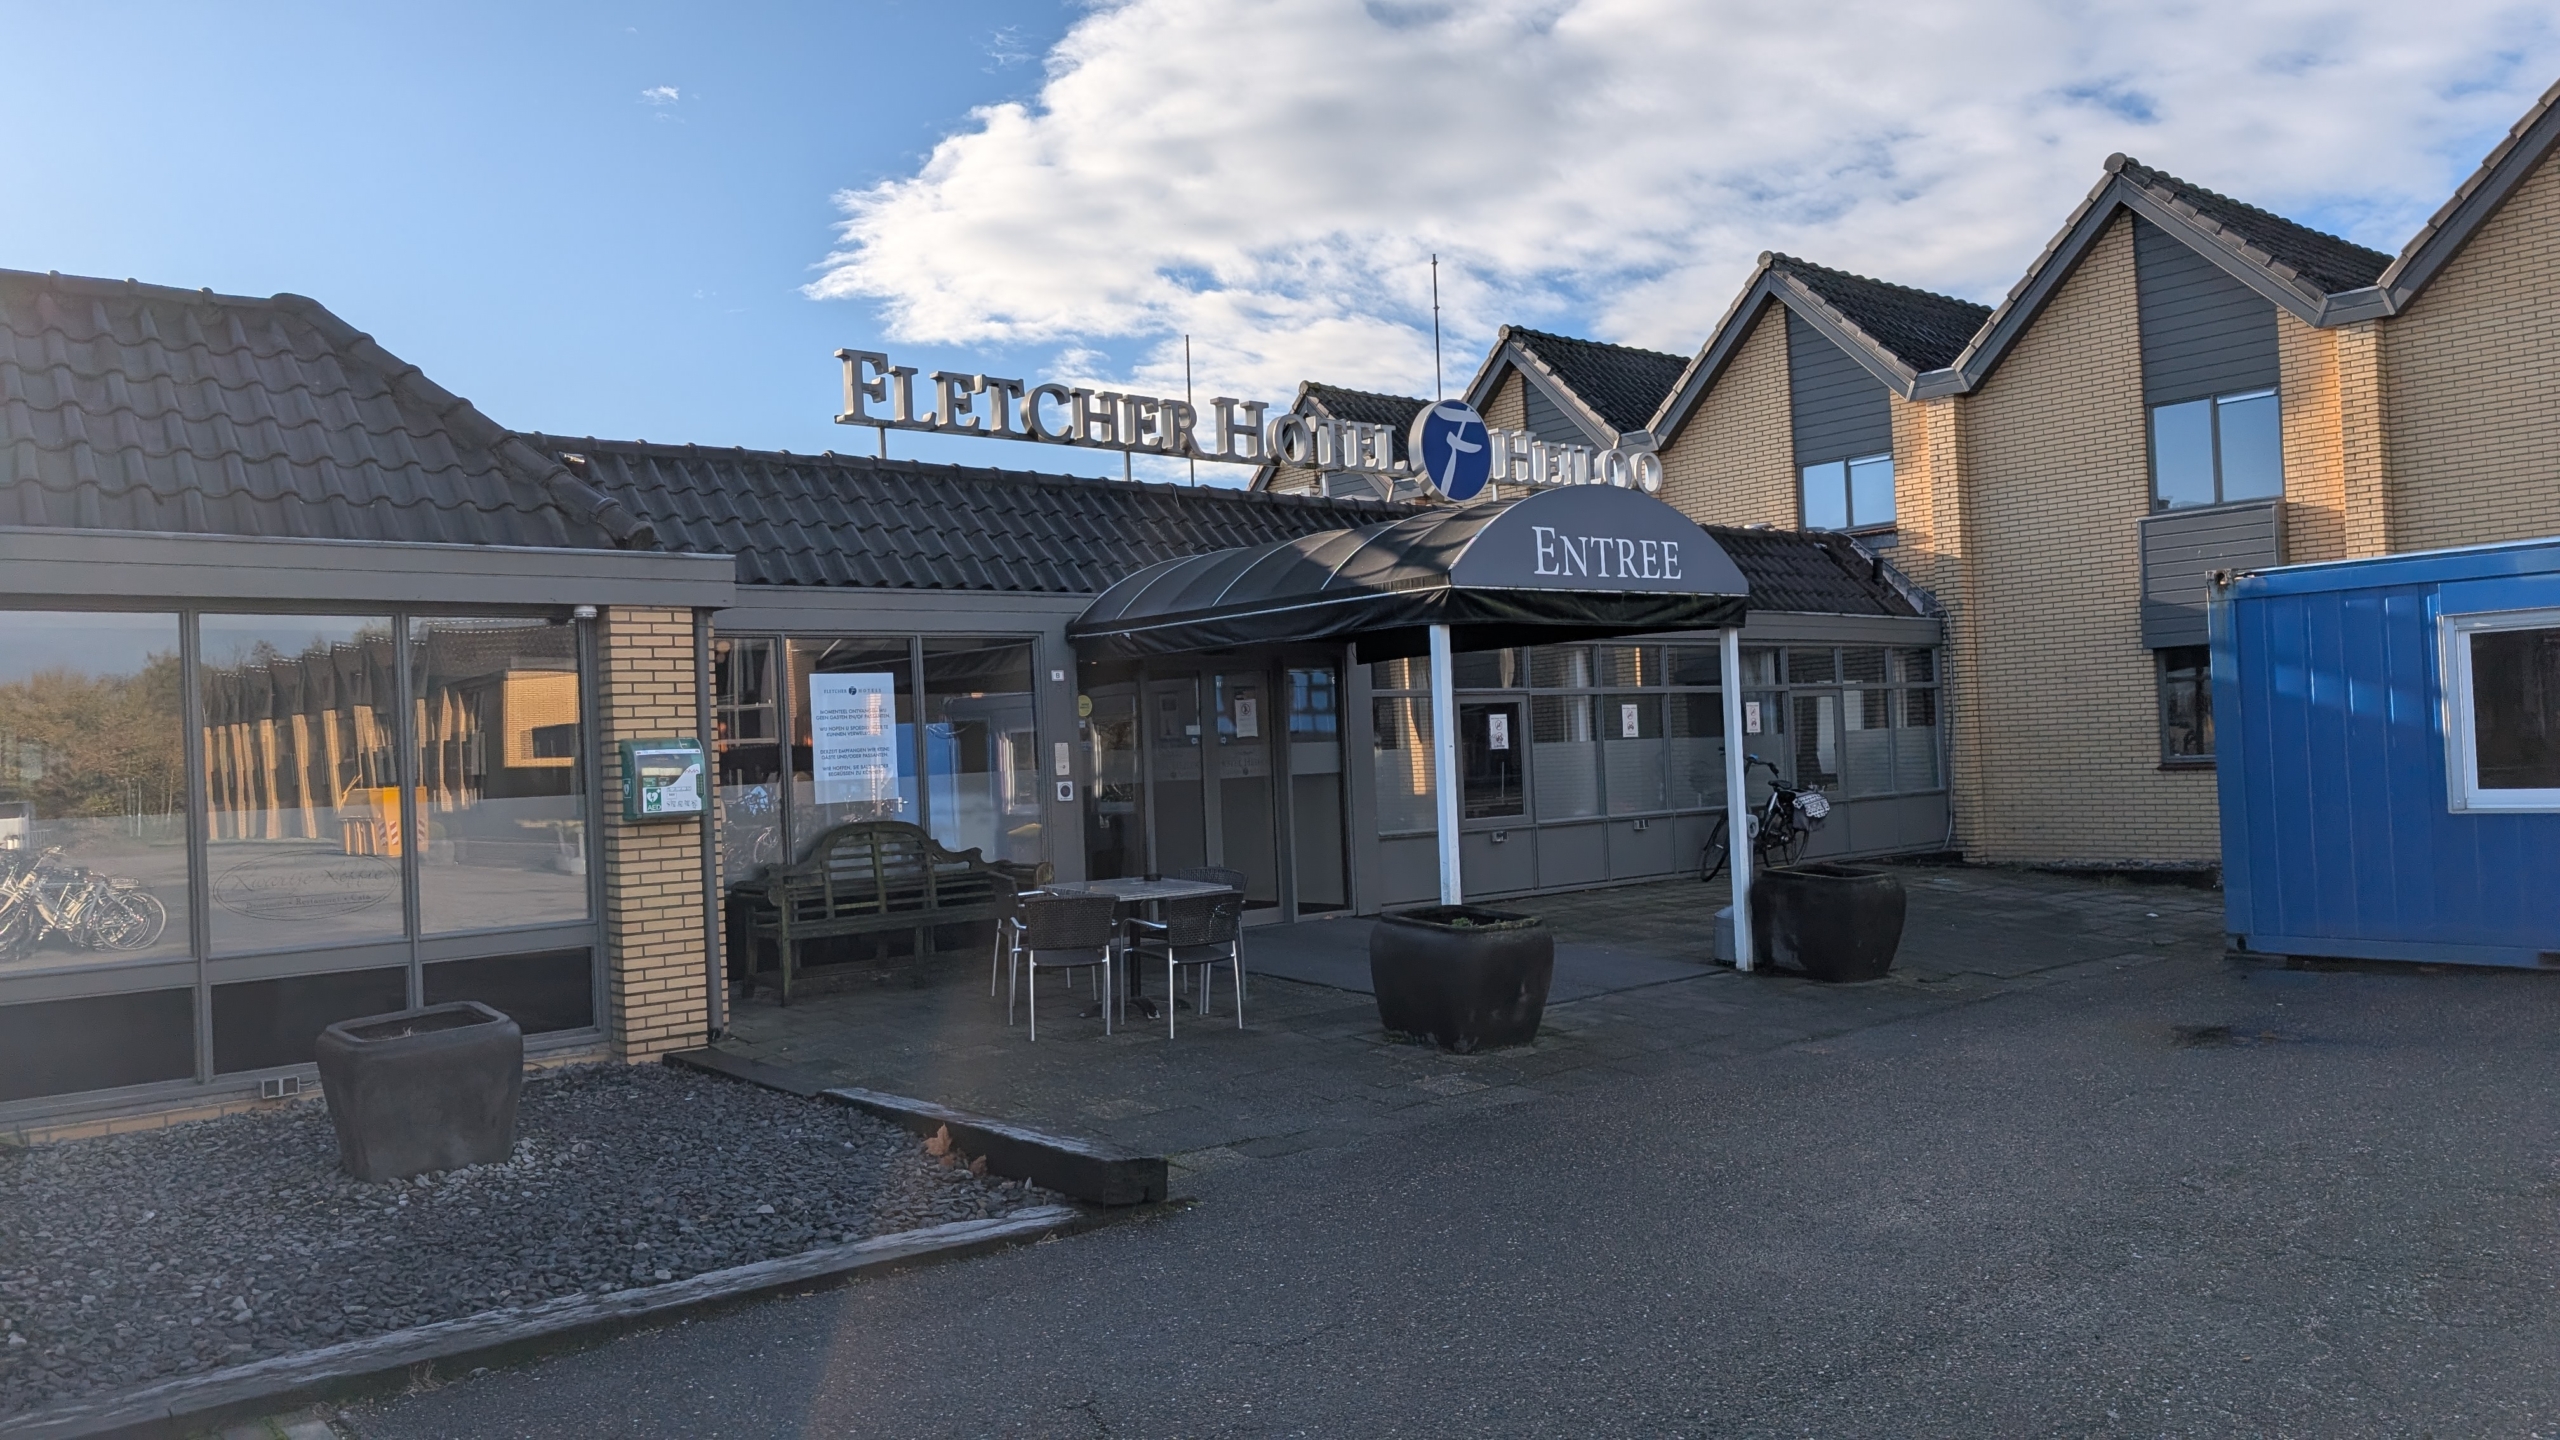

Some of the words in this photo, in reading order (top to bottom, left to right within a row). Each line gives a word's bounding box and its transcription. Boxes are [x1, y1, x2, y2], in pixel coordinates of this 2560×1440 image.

[834, 348, 1202, 460] FLETCHER
[1211, 397, 1408, 476] HOTEL
[1490, 428, 1663, 495] HEILOO
[1531, 525, 1682, 580] ENTREE
